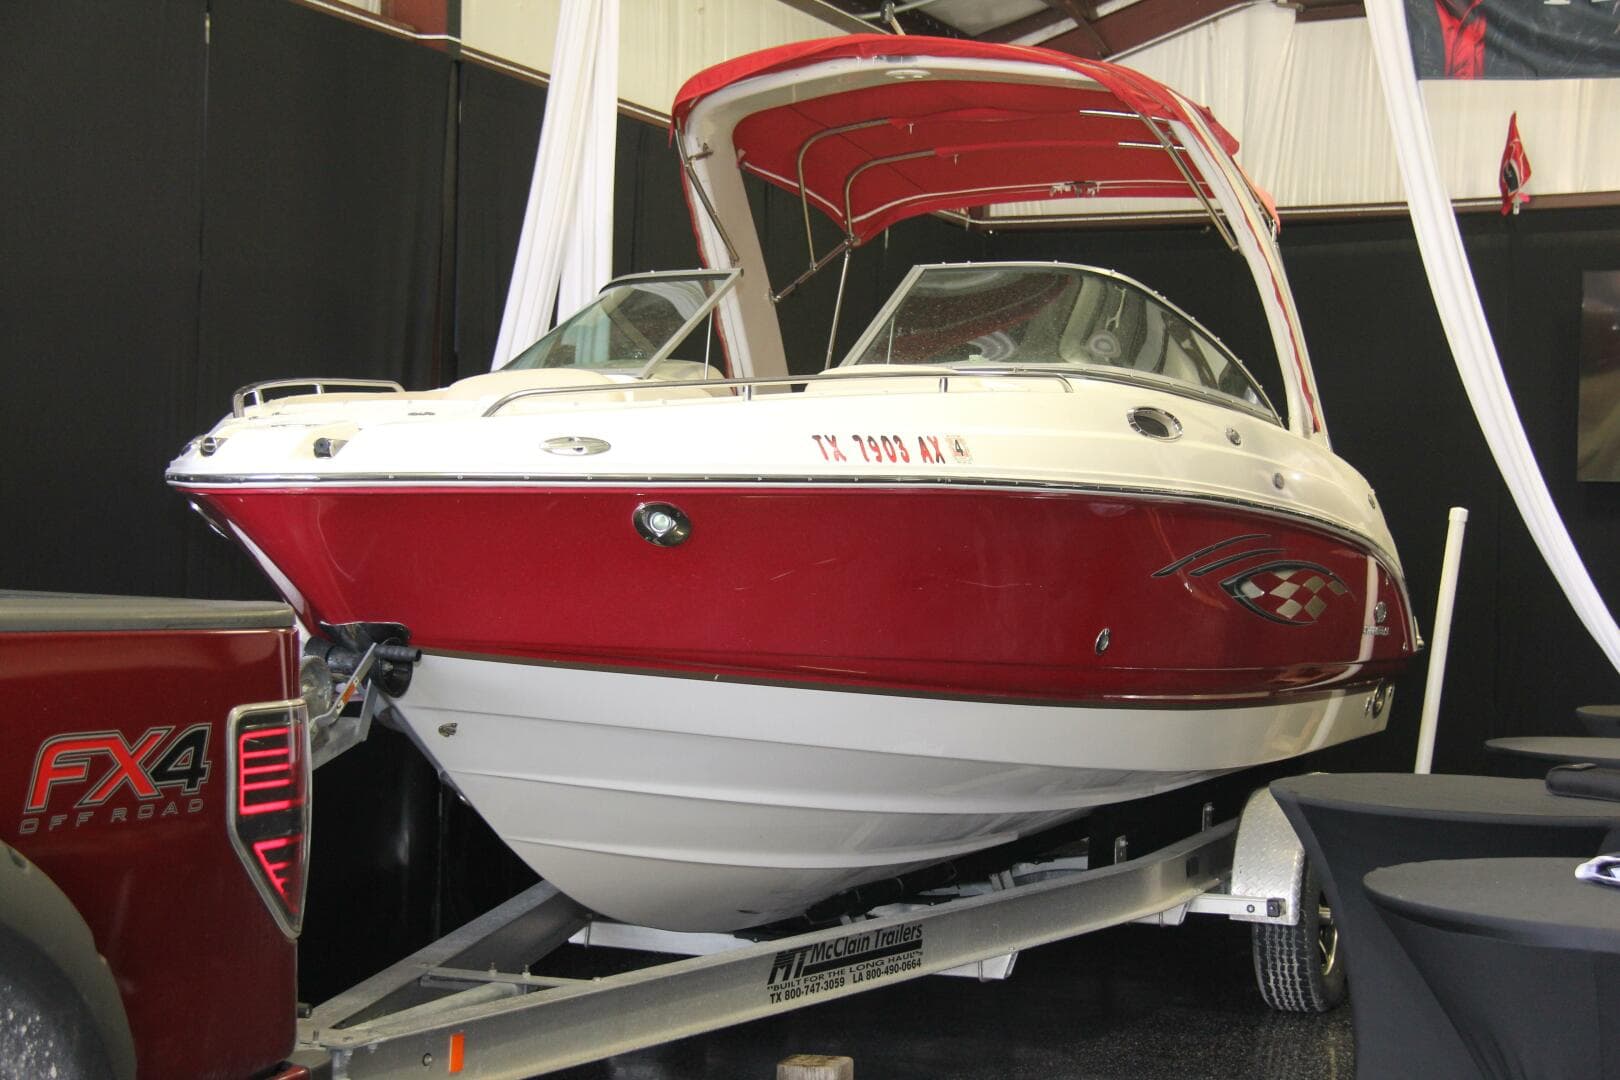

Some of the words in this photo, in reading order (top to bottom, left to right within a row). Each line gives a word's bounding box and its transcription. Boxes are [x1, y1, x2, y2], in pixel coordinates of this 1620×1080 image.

[812, 434, 847, 462] TX
[852, 434, 910, 463] 7903
[918, 436, 946, 464] AX
[954, 439, 964, 457] 4
[24, 722, 212, 814] FX4
[19, 810, 94, 834] OFF
[110, 798, 204, 823] ROAD
[809, 932, 870, 963] McClain
[874, 923, 923, 949] Trailers
[770, 992, 782, 1005] TX
[784, 977, 845, 1001] 800-747-3059
[853, 972, 864, 984] LA
[866, 958, 922, 980] 800-490-0664
[803, 973, 825, 984] FOR
[828, 967, 846, 978] THE
[849, 960, 885, 972] LONG
